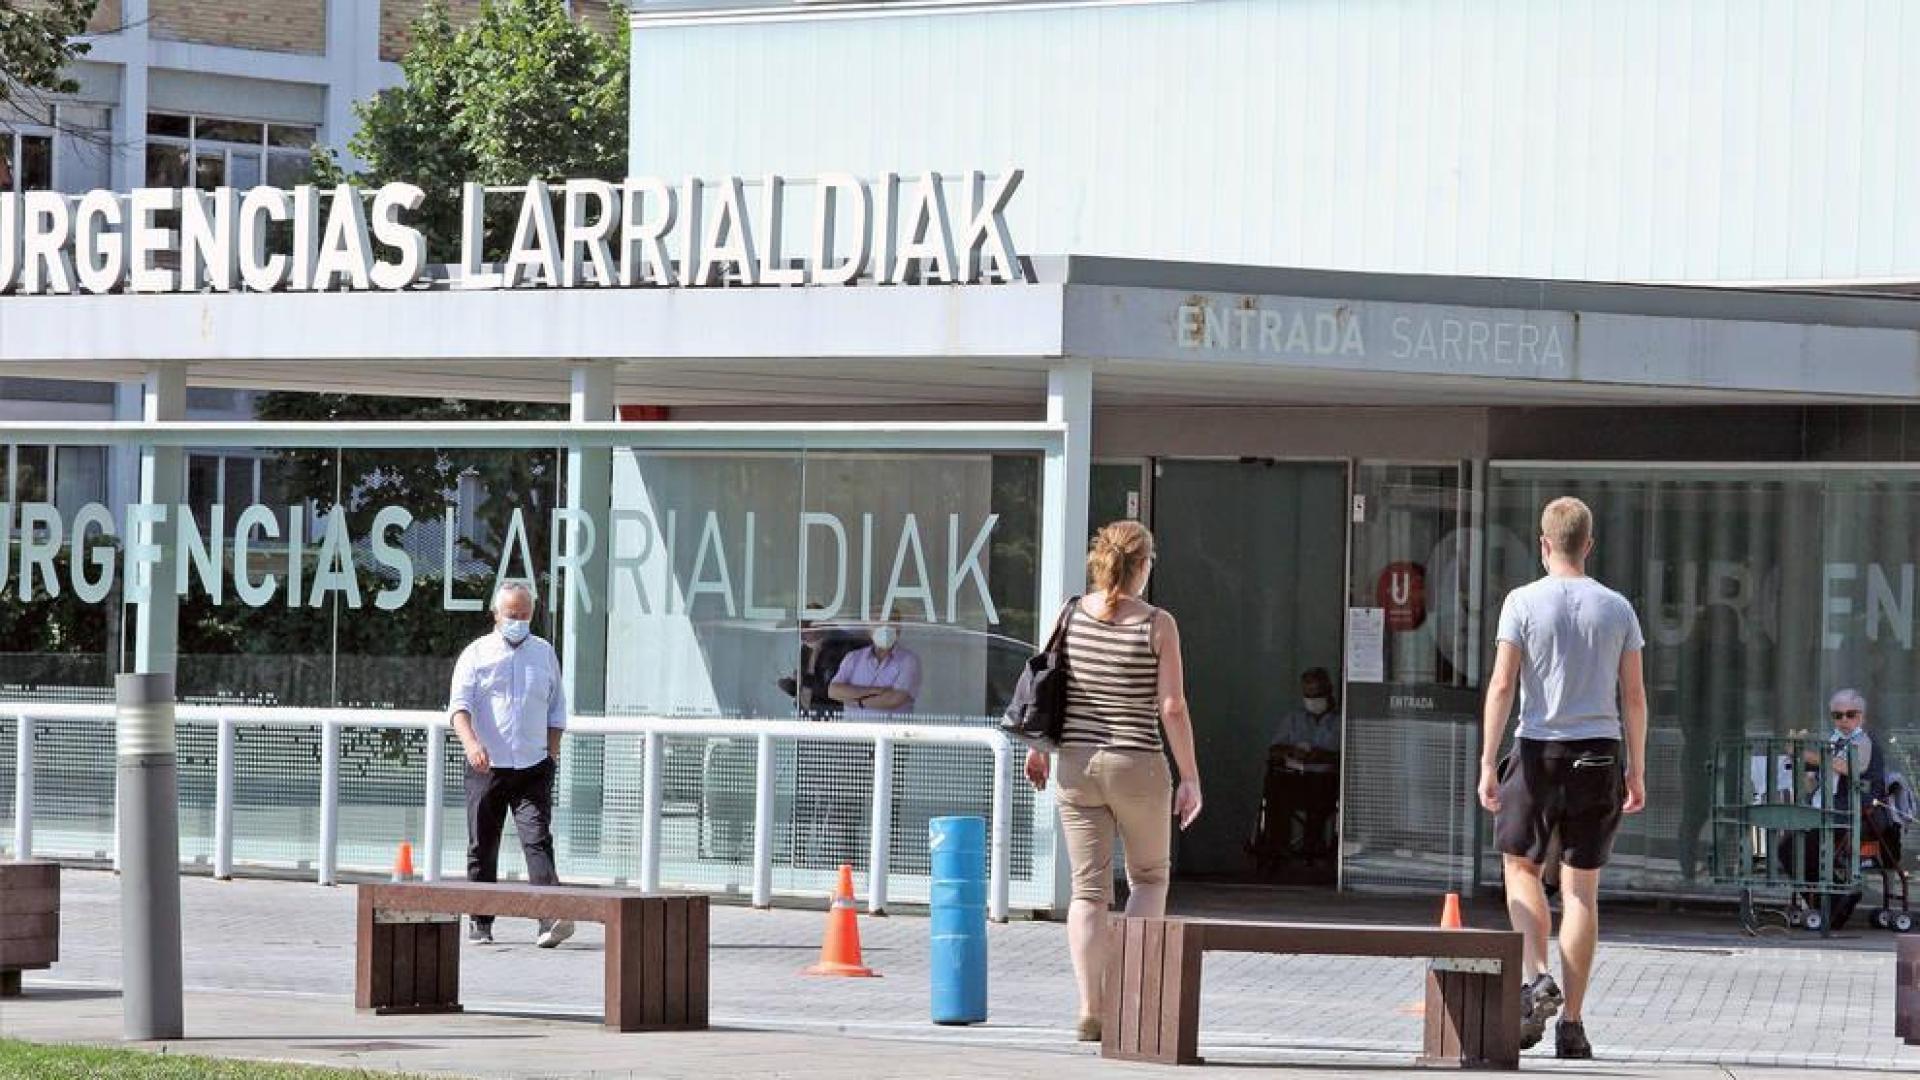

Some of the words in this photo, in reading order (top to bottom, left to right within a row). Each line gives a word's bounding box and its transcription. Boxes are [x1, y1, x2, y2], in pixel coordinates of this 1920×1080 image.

[459, 168, 1025, 289] LARRIALDIAK
[1177, 304, 1366, 357] ENTRADA
[1391, 316, 1566, 368] SARRERA
[0, 502, 415, 611] RGENCIAS
[443, 504, 1000, 624] LARRIALDIAK
[1391, 572, 1411, 607] U
